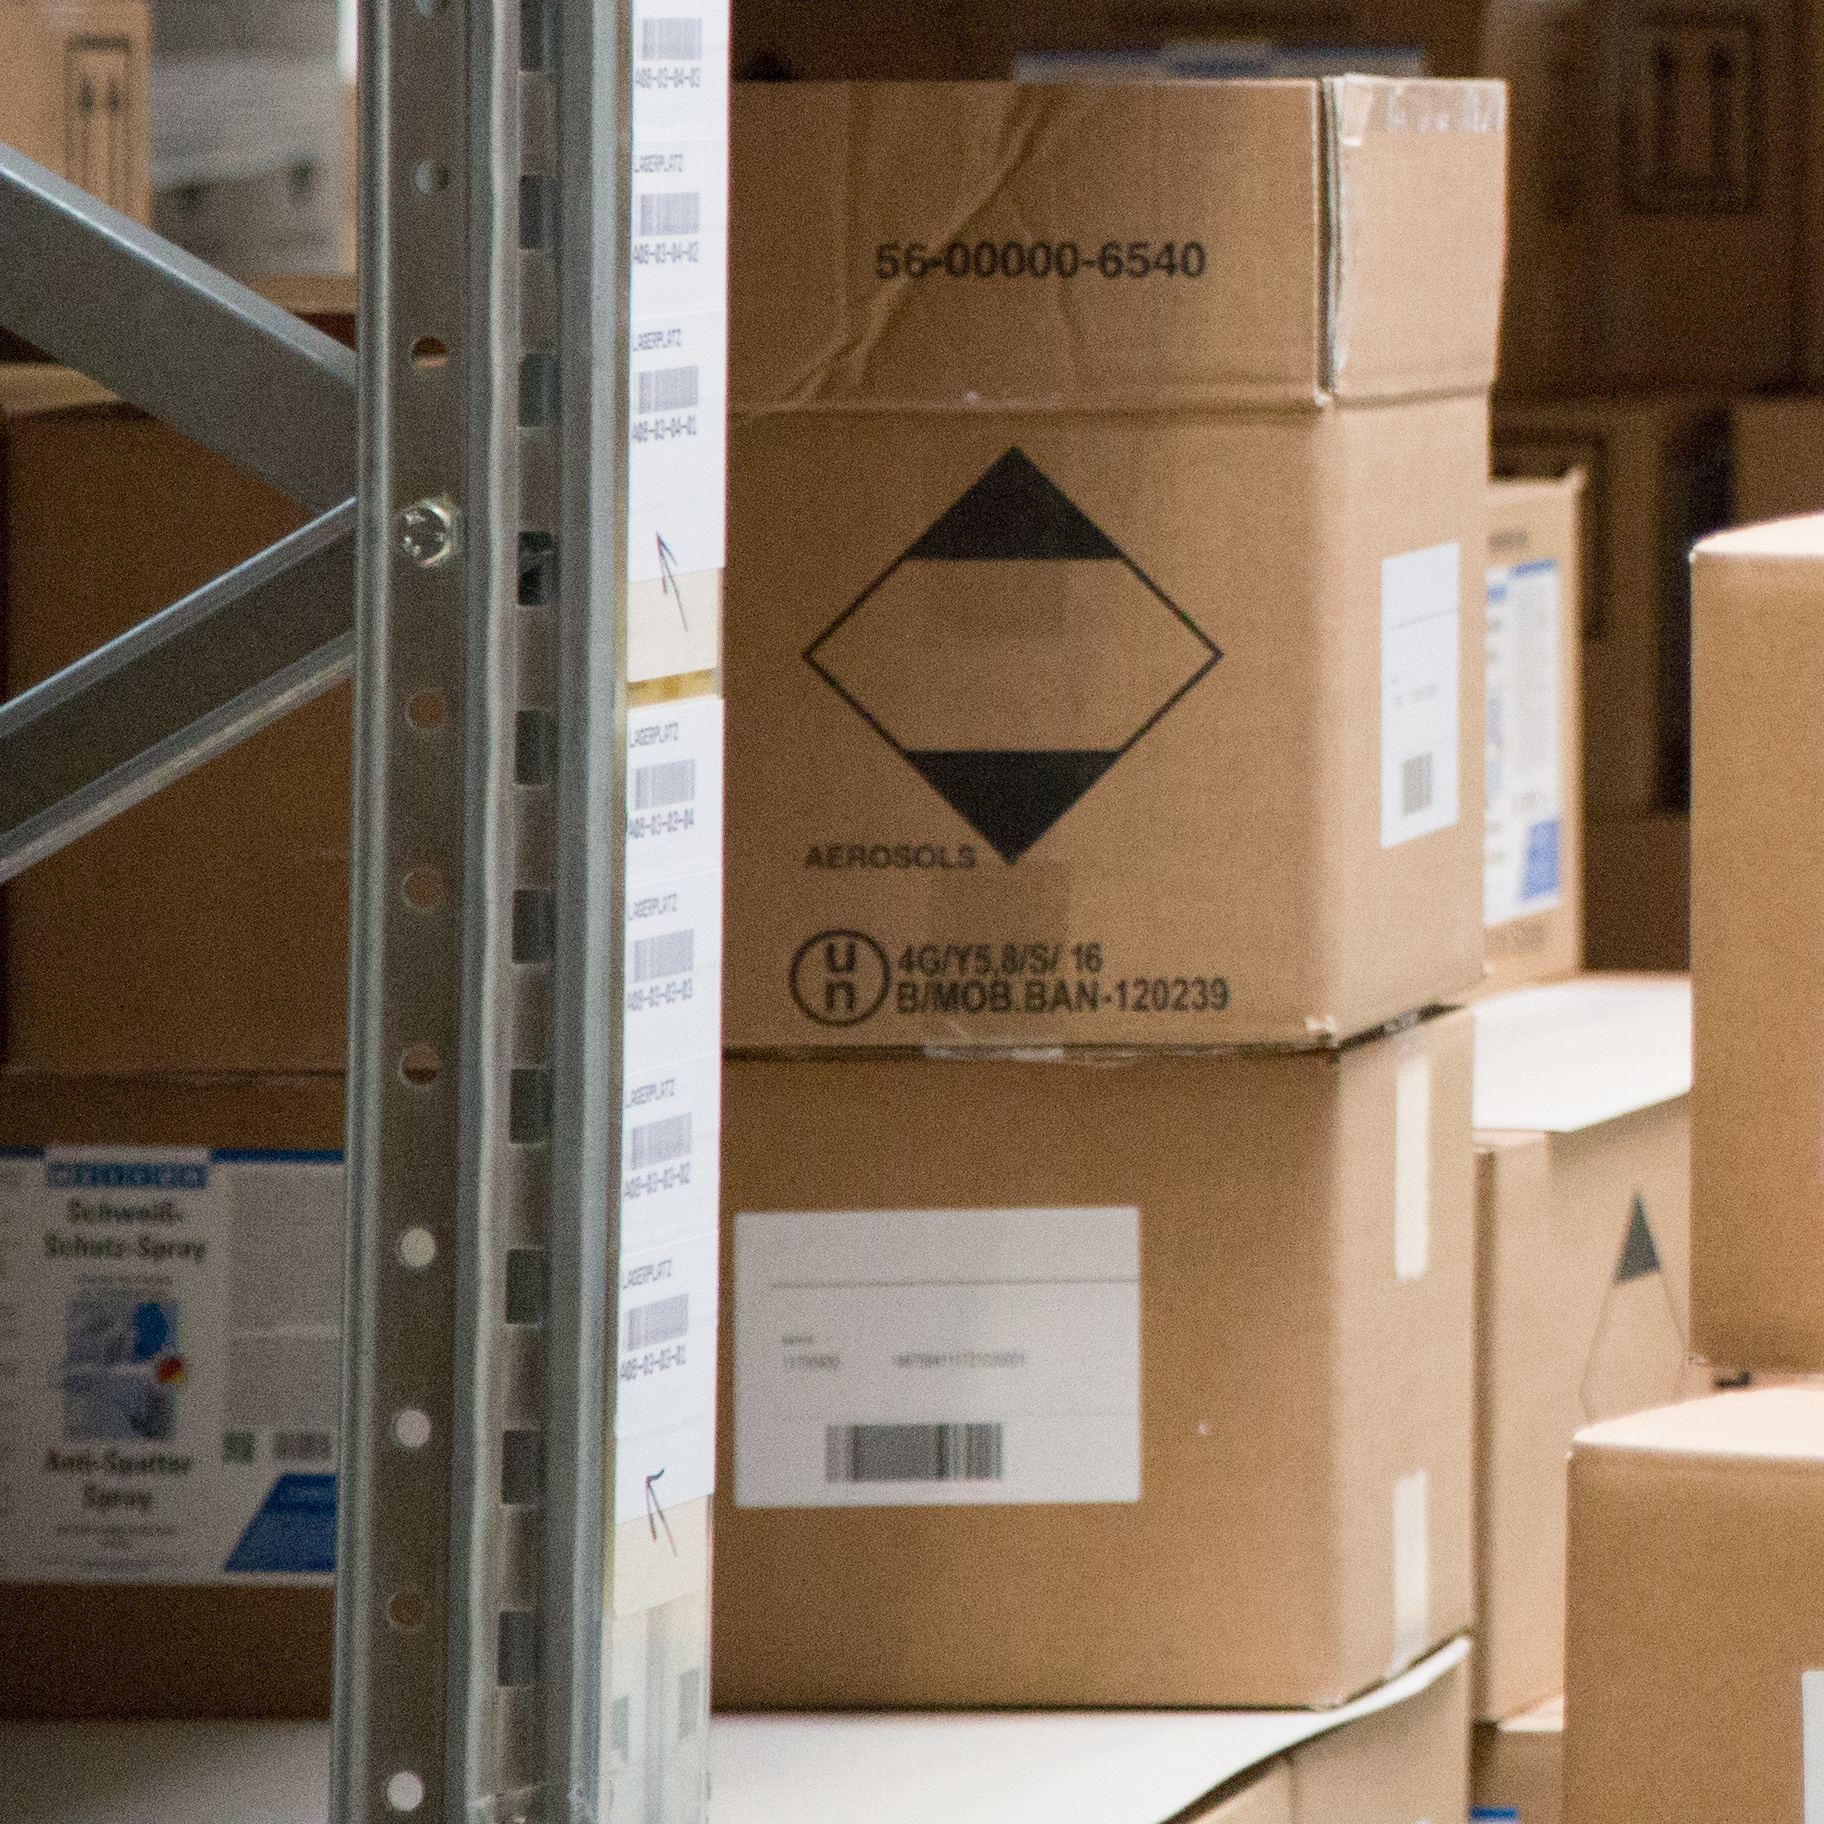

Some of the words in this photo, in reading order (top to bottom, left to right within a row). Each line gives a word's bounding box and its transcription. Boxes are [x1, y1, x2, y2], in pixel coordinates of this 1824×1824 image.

[875, 241, 1207, 278] 56-00000-6540
[804, 844, 978, 869] AEROSOLS
[1072, 942, 1102, 973] 16
